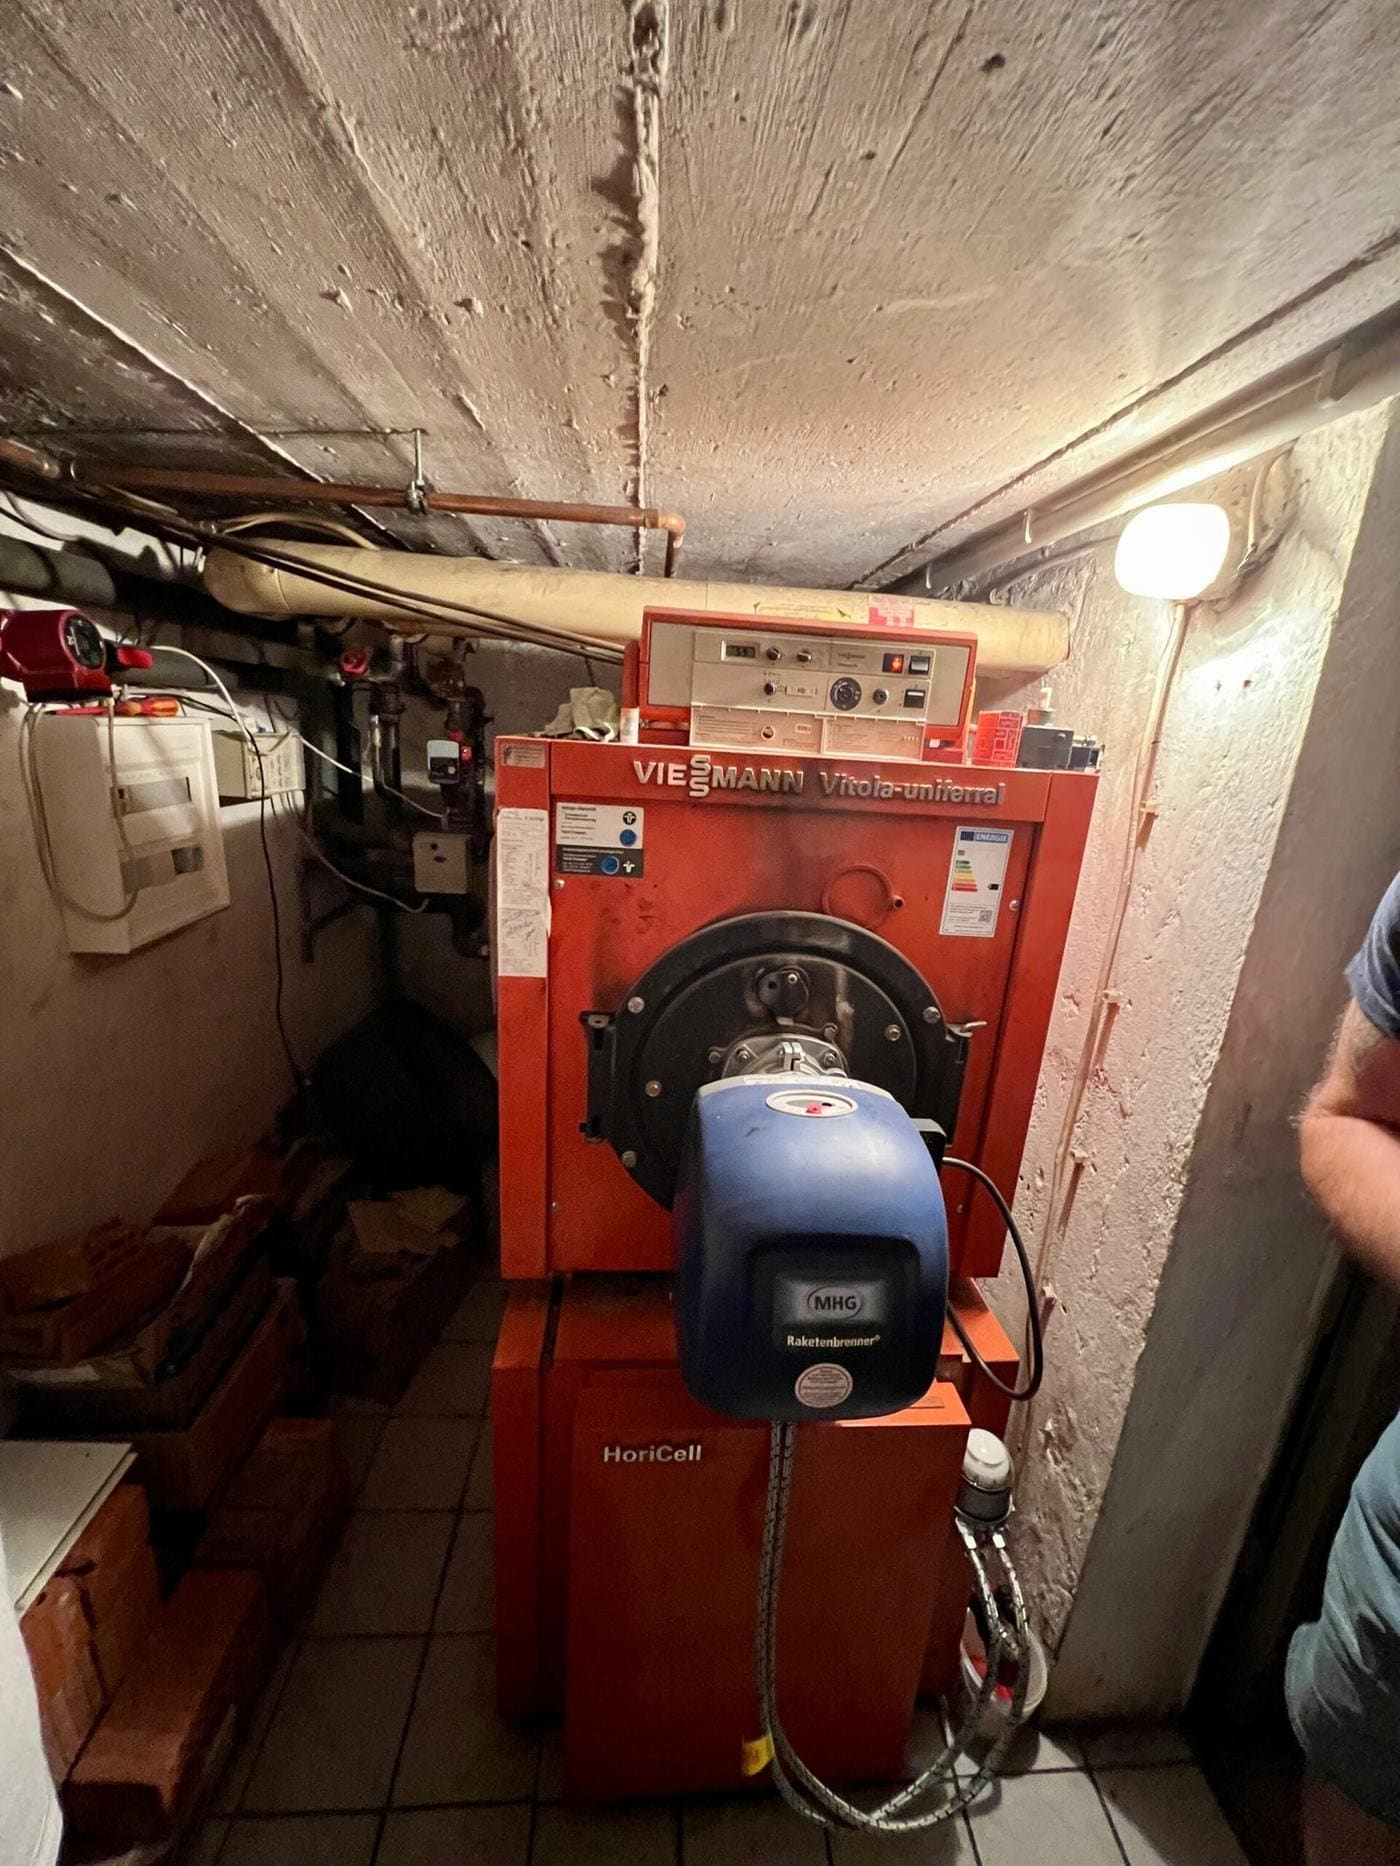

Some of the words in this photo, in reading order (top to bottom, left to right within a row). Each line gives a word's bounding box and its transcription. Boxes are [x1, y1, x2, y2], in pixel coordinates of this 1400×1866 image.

[633, 754, 804, 798] VIESSMANN
[819, 772, 1006, 804] Vitola-uniferral
[814, 1295, 857, 1311] MHG
[603, 1444, 702, 1463] HoriCell
